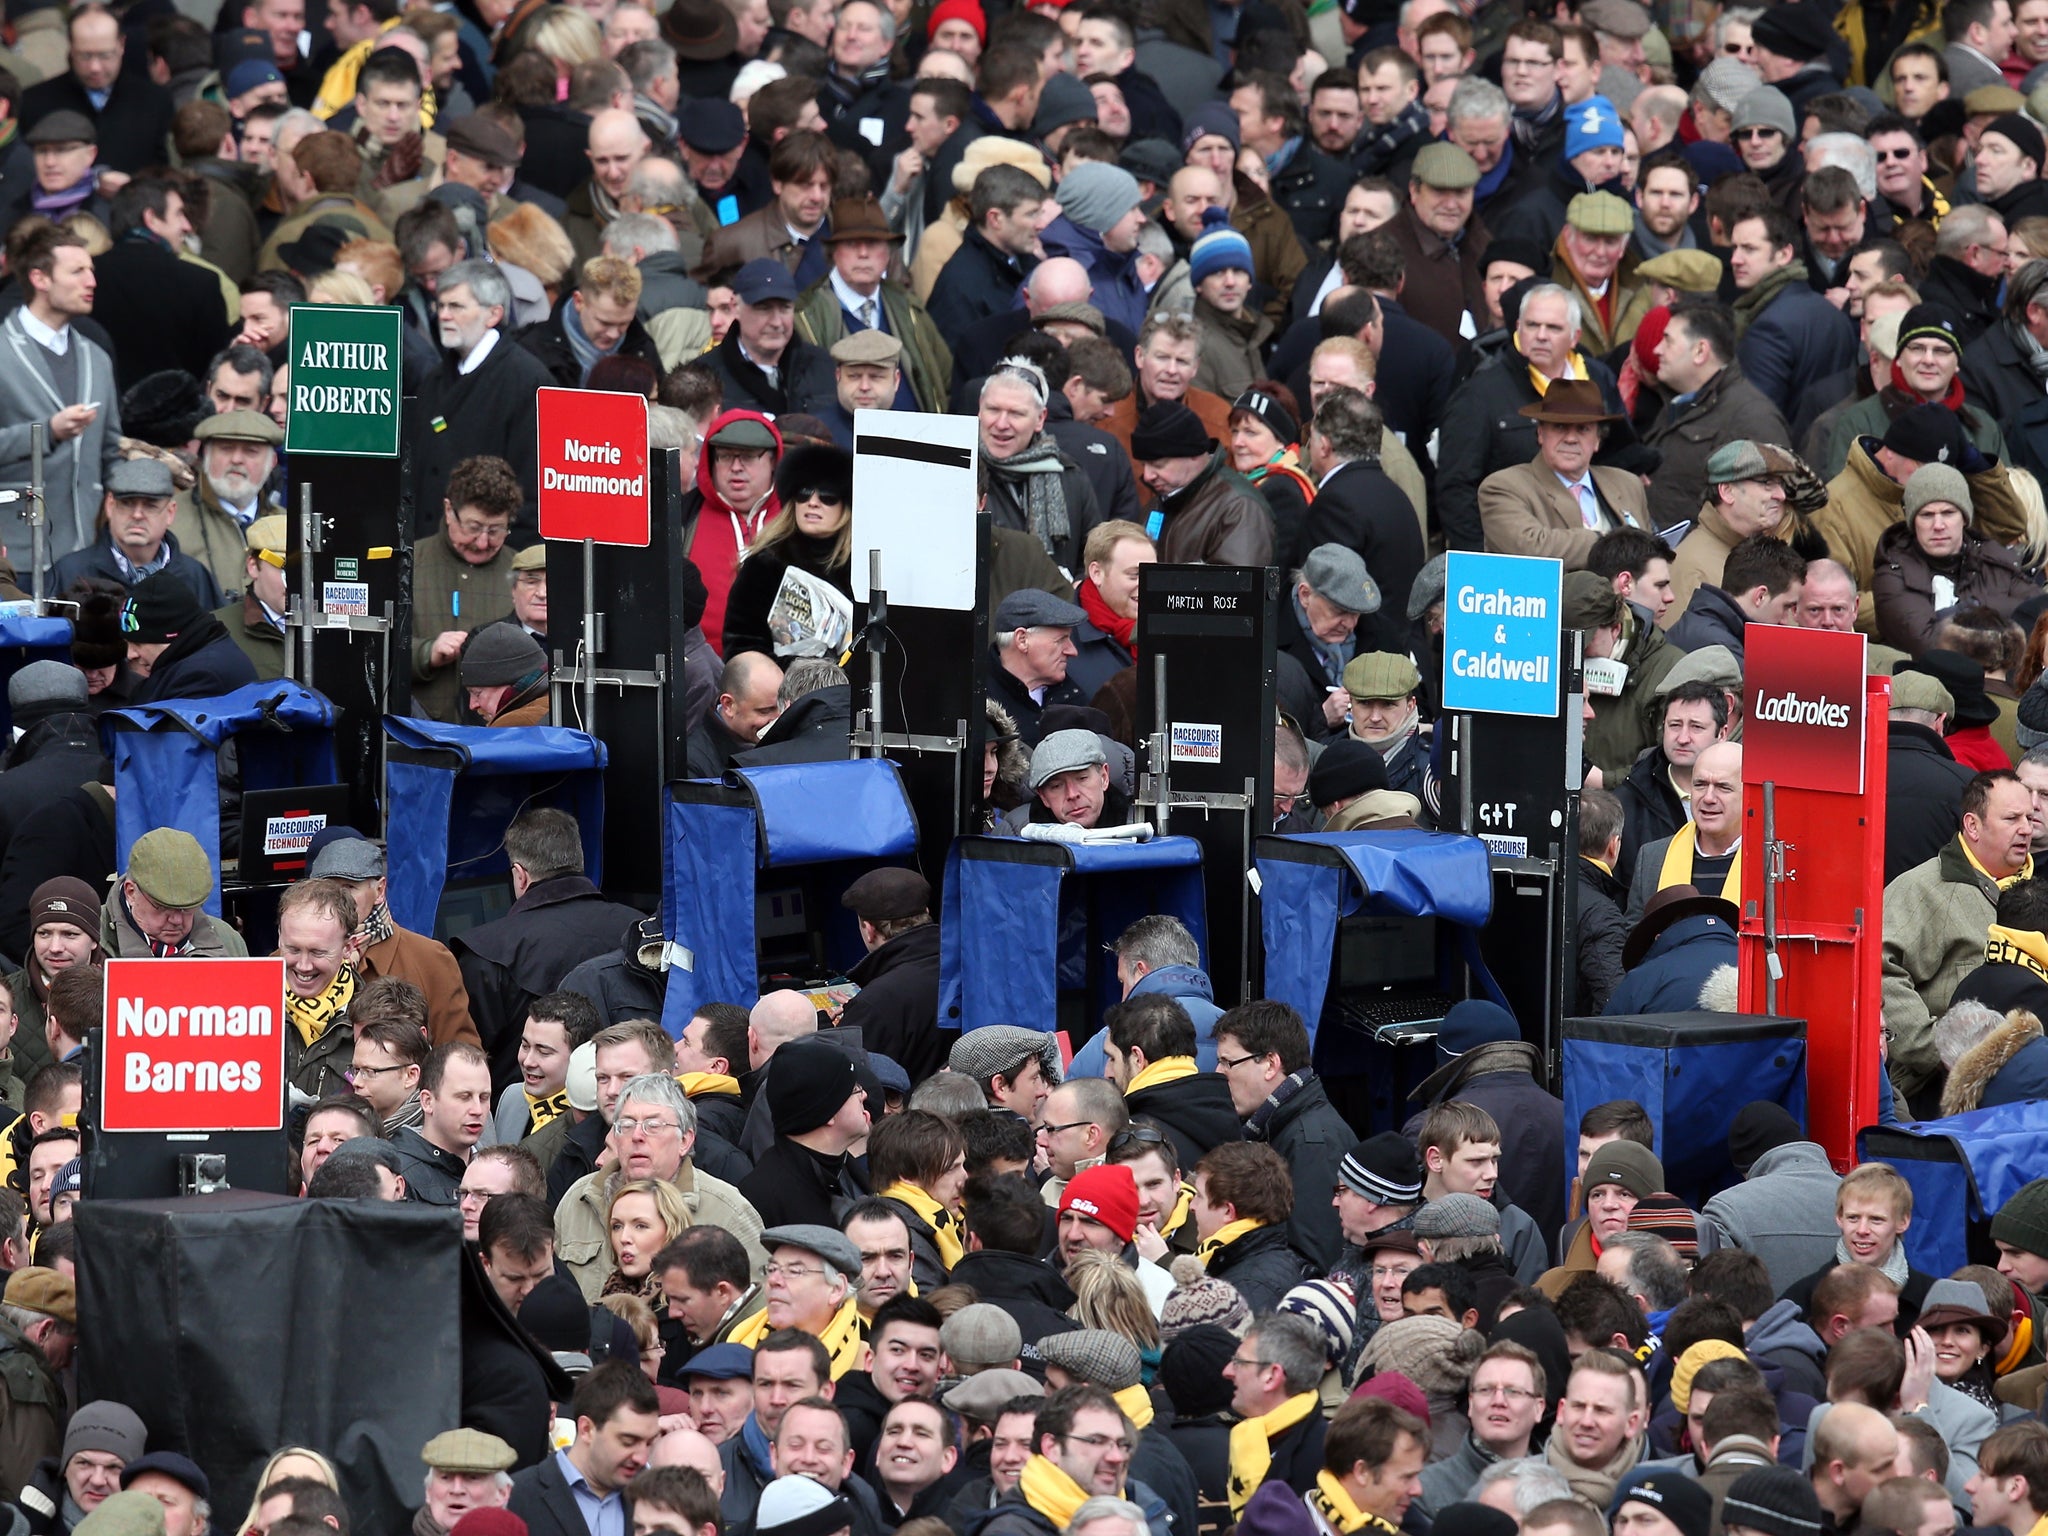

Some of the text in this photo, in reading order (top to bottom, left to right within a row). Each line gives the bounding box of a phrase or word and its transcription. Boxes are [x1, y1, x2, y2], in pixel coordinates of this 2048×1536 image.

[300, 341, 388, 371] ARTHUR
[295, 384, 392, 416] ROBERTS
[564, 438, 621, 465] Norrie
[543, 467, 644, 497] Drummond
[325, 586, 367, 600] RACECOURSE
[1167, 595, 1238, 610] MARTIN ROSE
[1458, 585, 1547, 618] Graham
[325, 603, 367, 616] TECHNOLOGIES
[1494, 624, 1507, 644] &
[1452, 649, 1549, 683] Caldwell
[1755, 689, 1850, 728] Ladbrokes
[1173, 728, 1220, 742] RACECOURSE
[1173, 745, 1220, 758] TECHNOLOGIES
[268, 820, 324, 835] RACECOURSE
[267, 836, 313, 850] TECHNOLOG
[1487, 840, 1526, 855] CECOURSE
[117, 997, 273, 1038] Norman
[124, 1052, 263, 1093] Barnes
